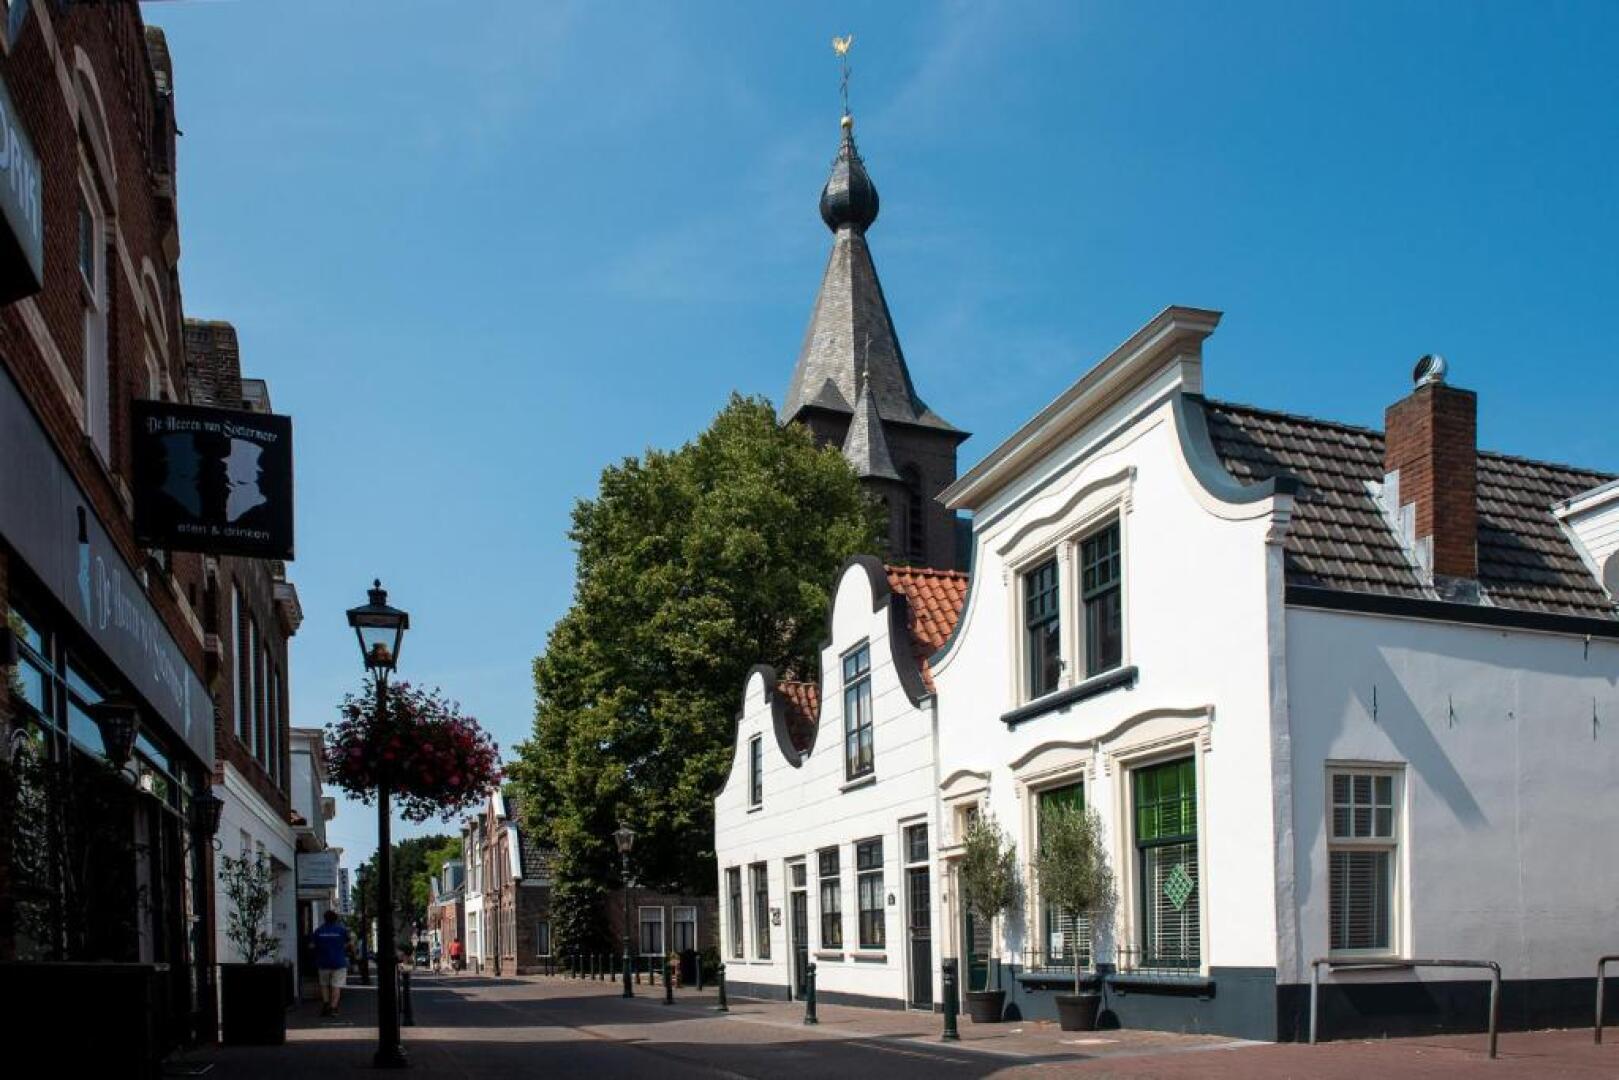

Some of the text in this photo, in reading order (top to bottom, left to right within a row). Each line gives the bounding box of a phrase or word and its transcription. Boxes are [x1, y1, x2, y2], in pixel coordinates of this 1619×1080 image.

[146, 415, 163, 435] De
[202, 421, 221, 433] van
[177, 523, 271, 542] eten & drinken
